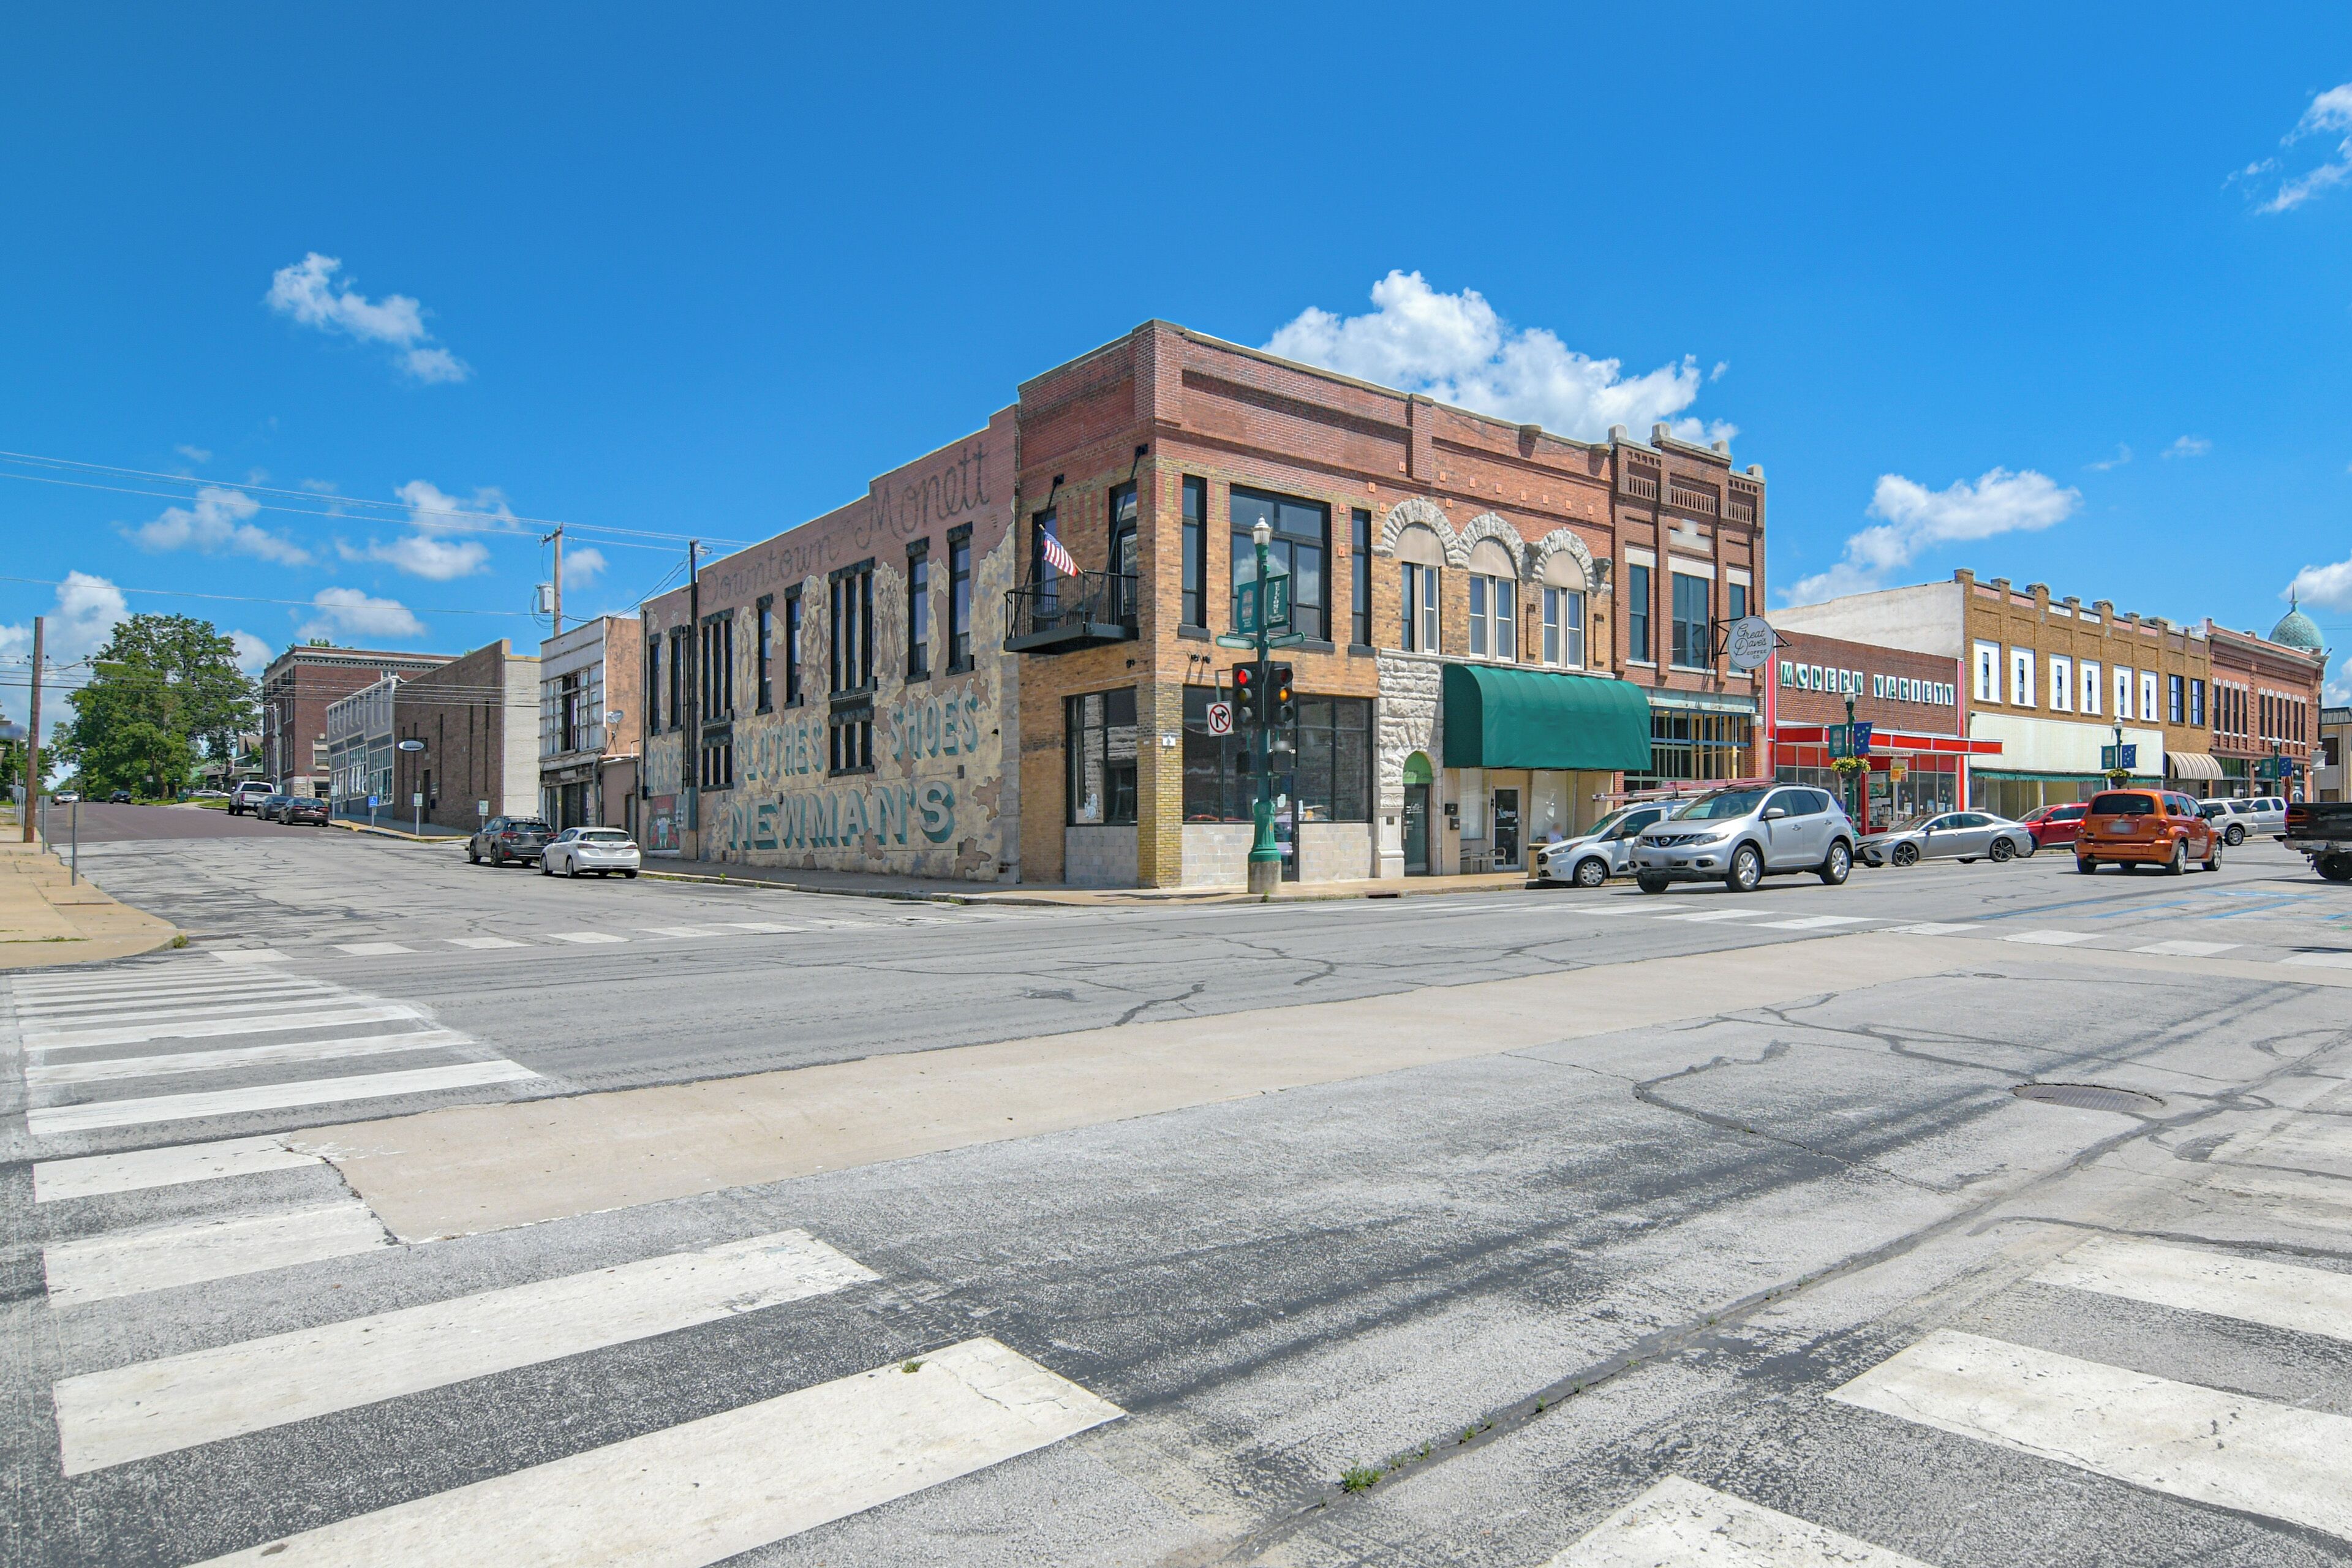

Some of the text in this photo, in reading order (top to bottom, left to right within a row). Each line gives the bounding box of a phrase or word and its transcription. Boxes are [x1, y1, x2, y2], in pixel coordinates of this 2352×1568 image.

[699, 440, 991, 605] Downtown Monett
[1733, 638, 1767, 657] Dave's
[1737, 623, 1765, 639] Great
[1781, 662, 1954, 705] MODERN VARIETY
[736, 687, 979, 781] CLOTHES SHOES
[727, 780, 956, 851] NEWMAN'S
